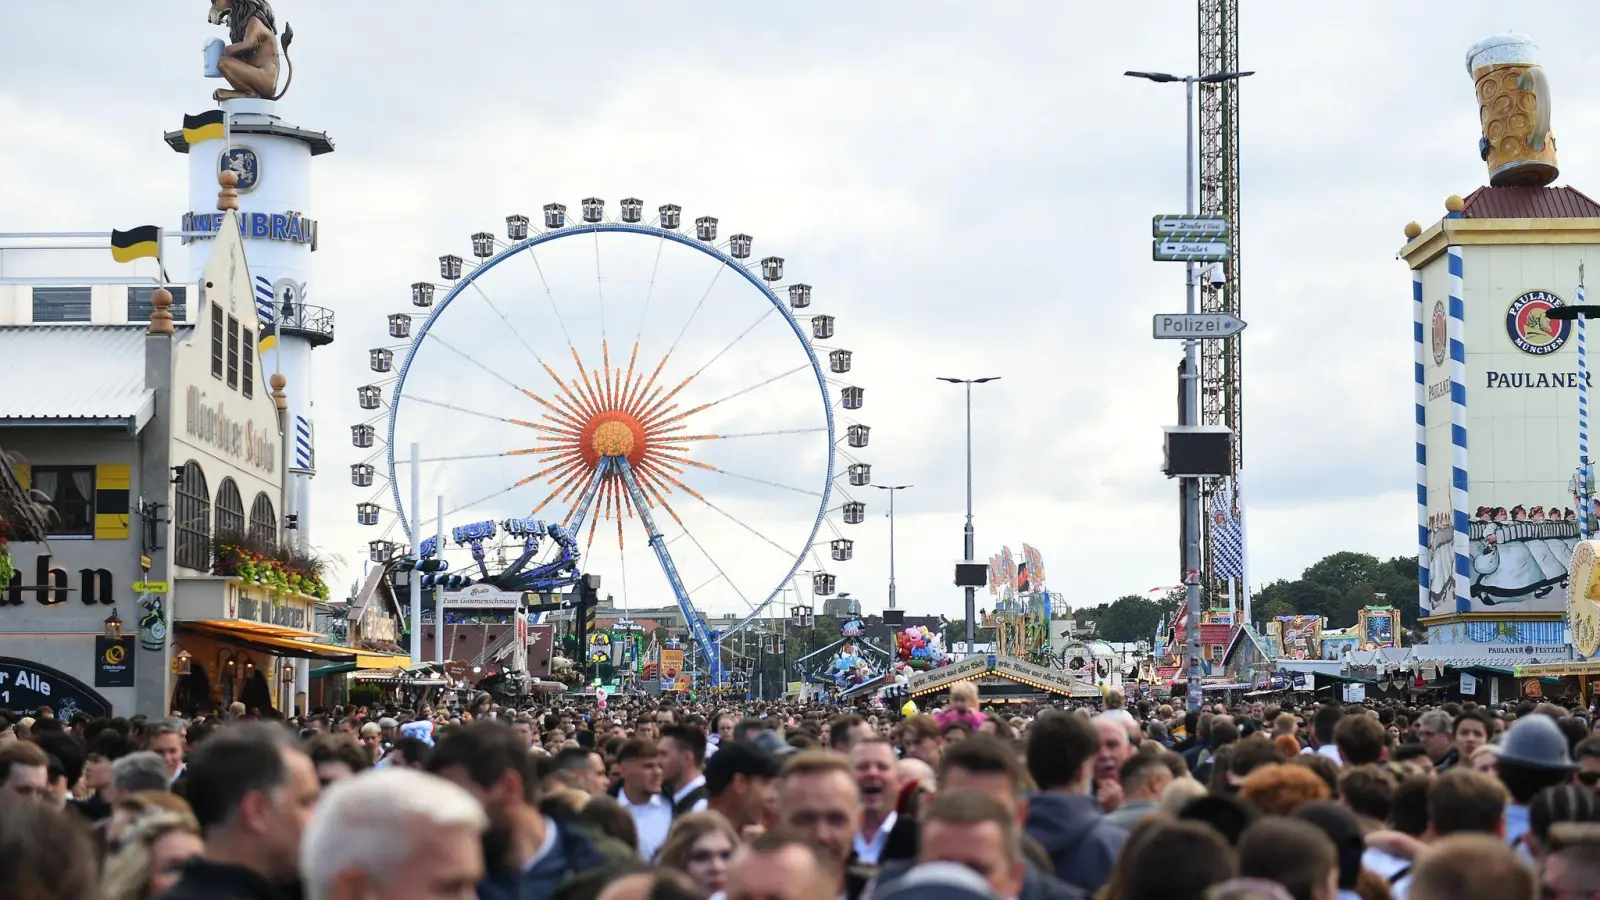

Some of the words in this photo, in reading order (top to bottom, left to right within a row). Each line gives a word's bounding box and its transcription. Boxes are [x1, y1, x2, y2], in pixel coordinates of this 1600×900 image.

[1509, 291, 1565, 316] PAULANE
[1163, 318, 1220, 332] Polizei
[1514, 337, 1564, 354] MÜNCHEN
[442, 597, 459, 605] Zum
[1535, 646, 1566, 654] FESTZELT
[15, 670, 51, 696] Alle
